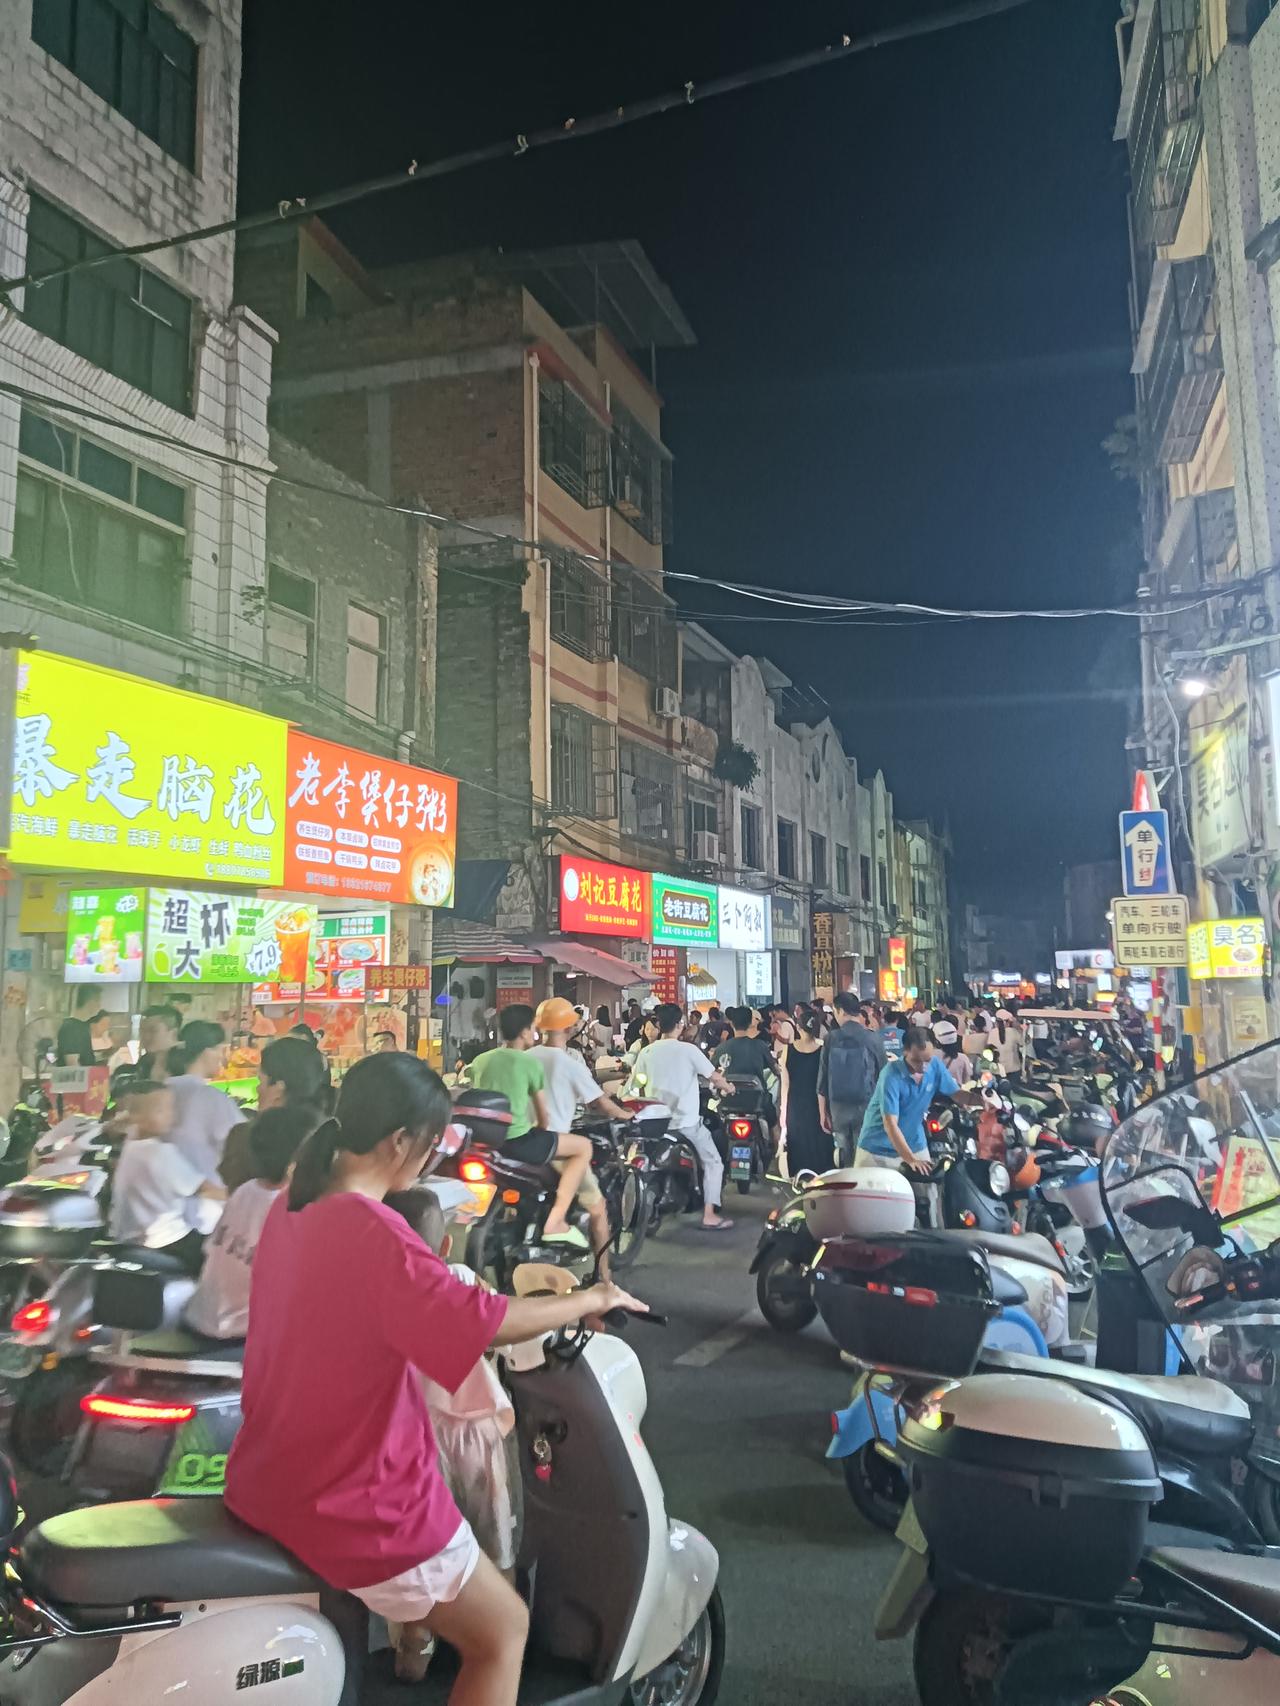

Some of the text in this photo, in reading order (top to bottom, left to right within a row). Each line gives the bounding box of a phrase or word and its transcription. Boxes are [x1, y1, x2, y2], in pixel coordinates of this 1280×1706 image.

[13, 712, 276, 836] 暴走脑花
[288, 751, 448, 834] 老李煲仔粥
[1136, 829, 1153, 881] 单行线
[580, 871, 643, 913] 刘记豆腐花
[663, 896, 709, 922] 老街豆腐花
[1122, 921, 1182, 935] 单向行驶
[235, 1657, 281, 1691] 绿源
